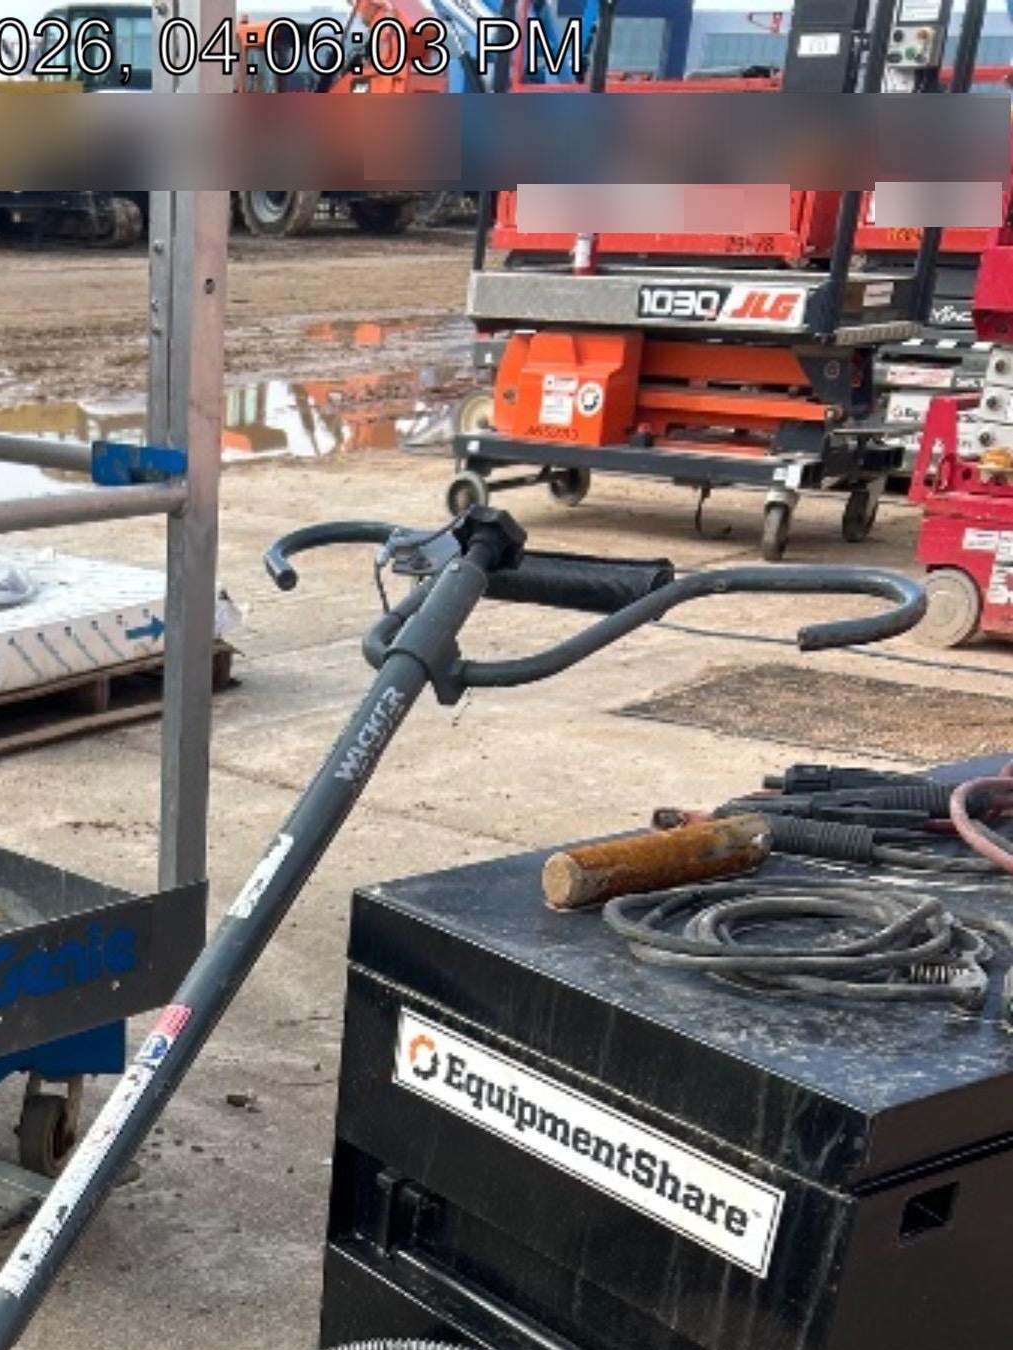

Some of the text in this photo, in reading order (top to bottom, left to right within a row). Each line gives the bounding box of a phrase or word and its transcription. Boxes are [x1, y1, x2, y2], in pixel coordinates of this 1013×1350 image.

[640, 289, 801, 321] 1030 JLG
[443, 1052, 748, 1237] EquipmentShare
